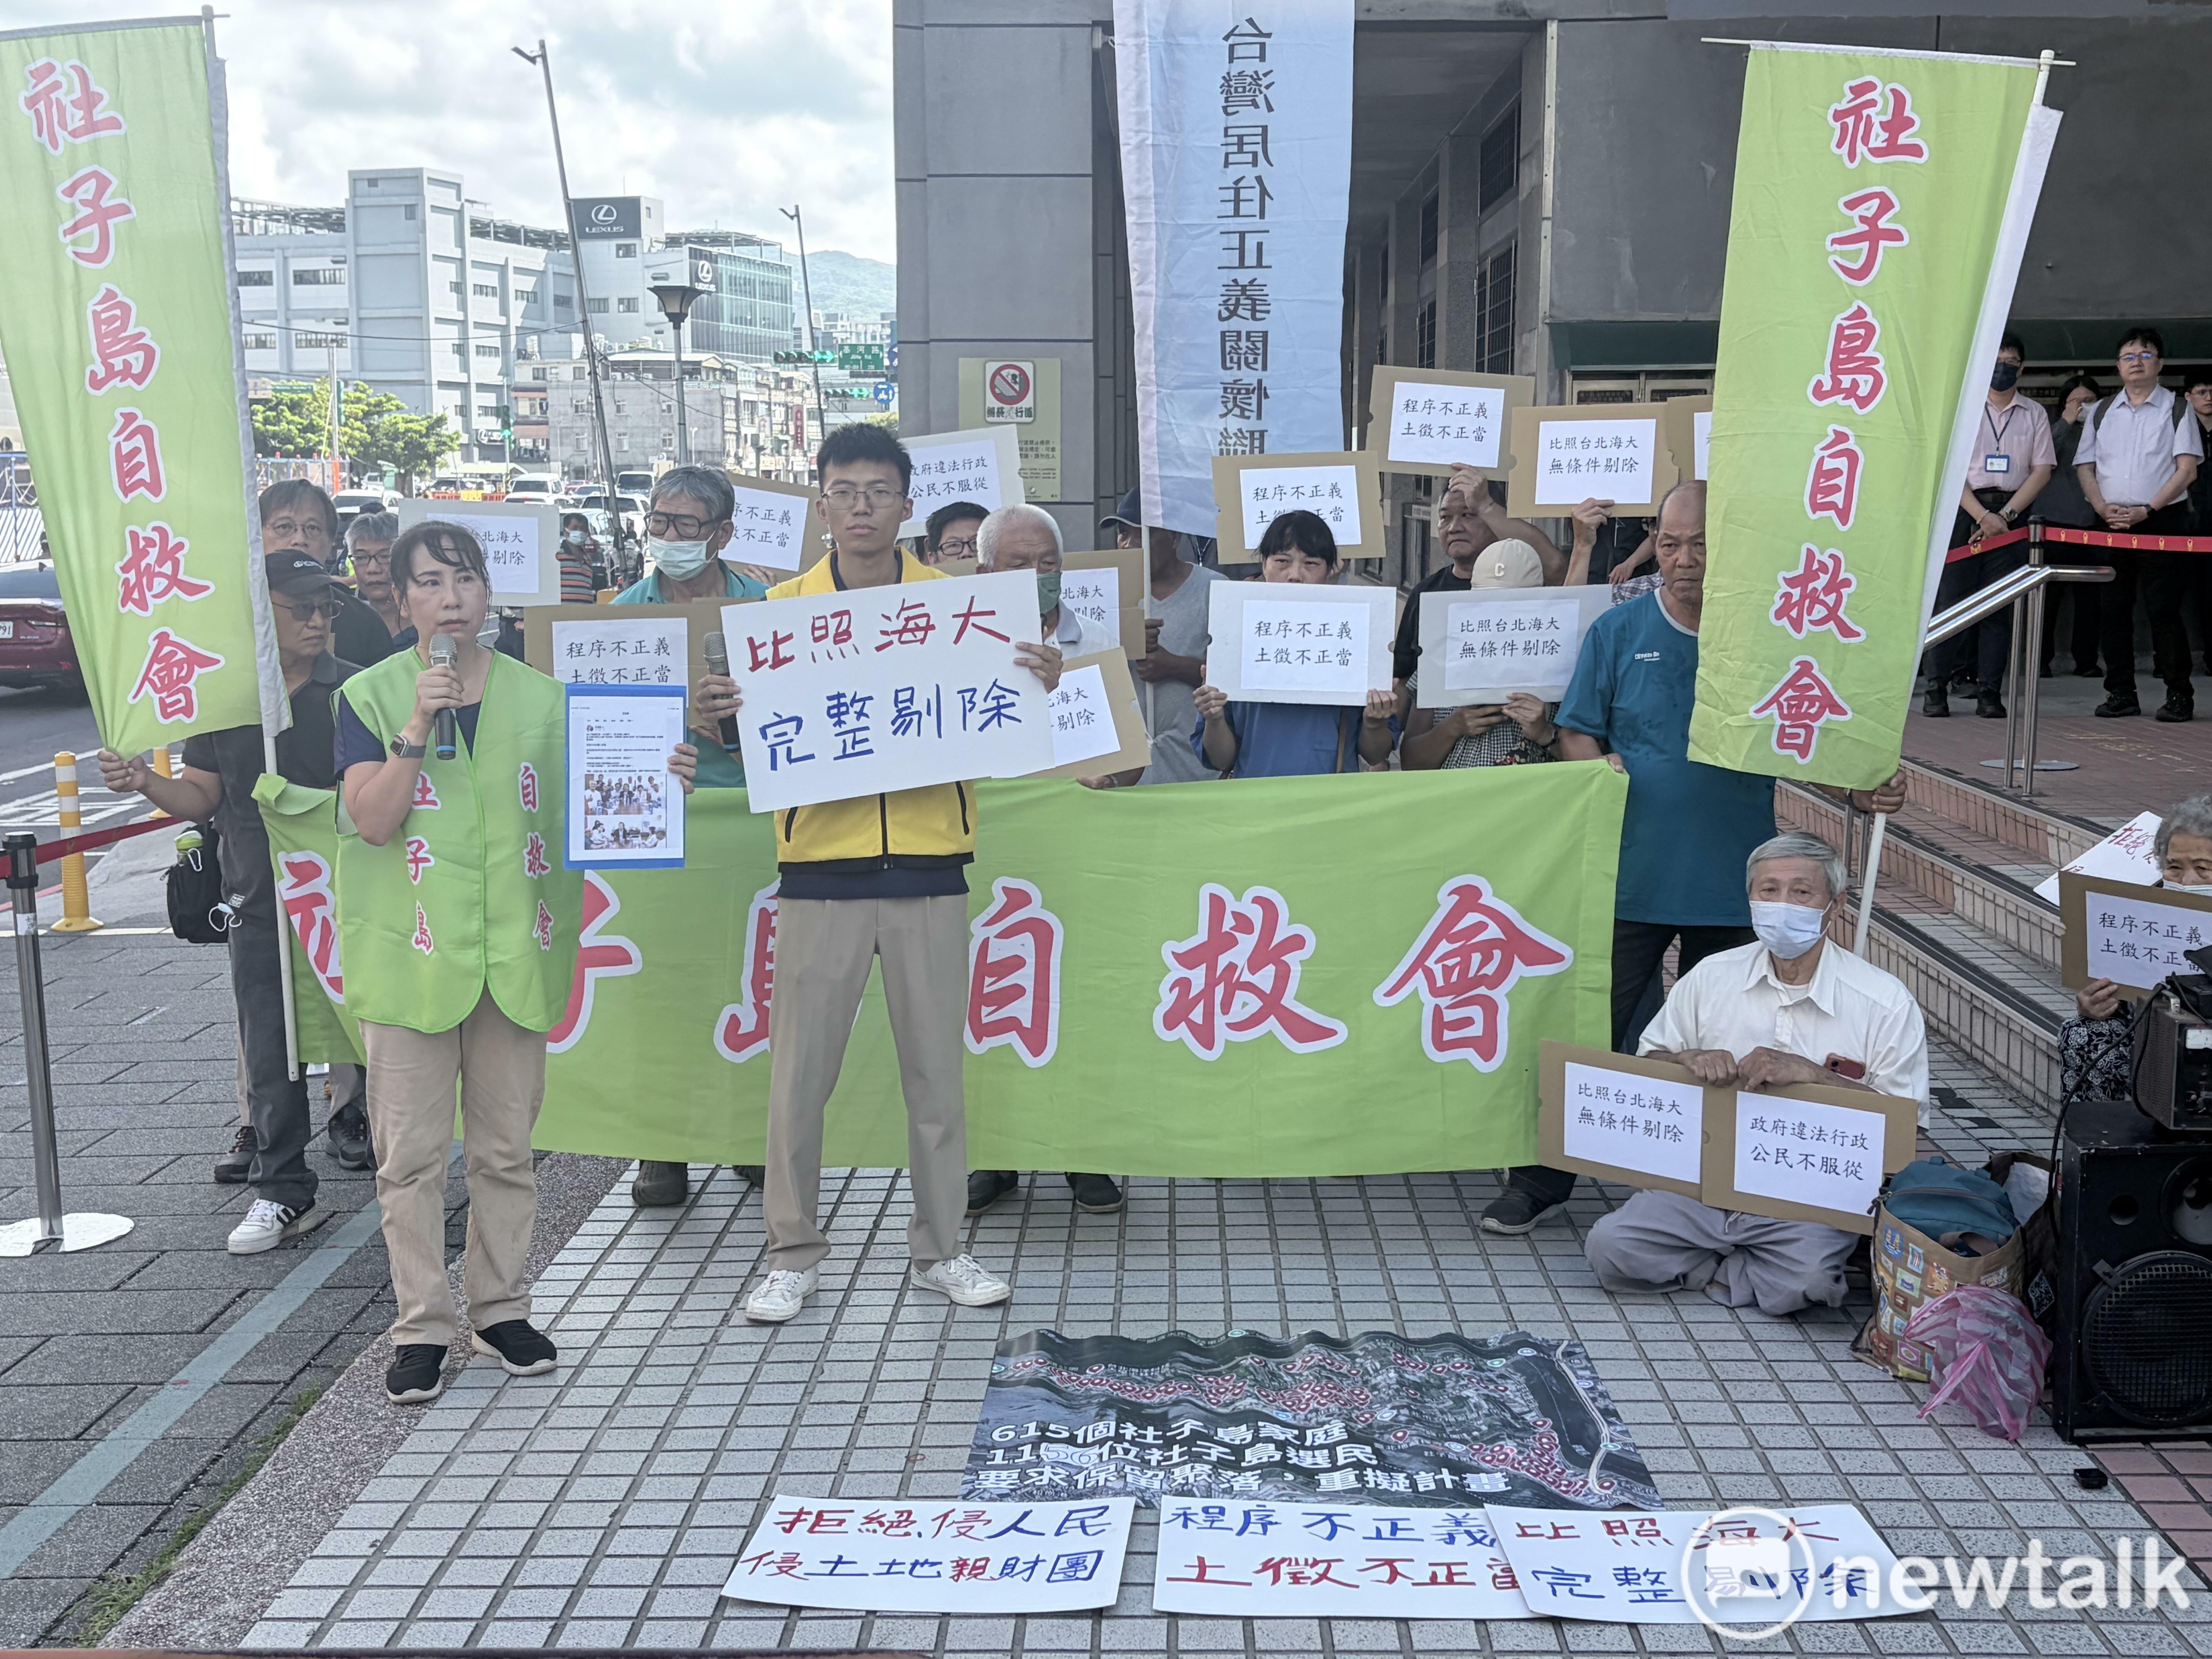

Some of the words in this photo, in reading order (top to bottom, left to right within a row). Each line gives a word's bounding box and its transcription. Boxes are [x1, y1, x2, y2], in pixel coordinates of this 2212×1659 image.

[22, 59, 223, 721] 社子島自救會
[1402, 398, 1487, 419] 程序不正義
[1752, 77, 1926, 761] 社子島自救會
[1401, 422, 1486, 442] 土徵不正當
[1550, 436, 1638, 449] 比照台北海大
[1549, 457, 1639, 474] 無條件剔除
[911, 477, 988, 498] 公民不服從
[1253, 482, 1343, 501] 程序不正義
[1256, 506, 1344, 524] 土正當
[484, 550, 525, 565] 剔除
[1495, 563, 1504, 577] C
[748, 595, 1011, 672] 比照海大
[1255, 620, 1352, 640] 程序不正義
[1461, 617, 1560, 632] 比照台北海大
[566, 637, 670, 658] 程序不正義
[1255, 647, 1352, 666] 土徵不正當
[1460, 639, 1561, 658] 無條件剔除
[570, 665, 671, 684] 土徵不正當
[759, 678, 1022, 771] 完整剔除
[1051, 709, 1095, 732] 剔除
[520, 763, 553, 950] 自救會
[2099, 912, 2203, 946] 程序不正義
[1578, 1083, 1683, 1116] 比照台北海大
[1577, 1106, 1685, 1144] 無條件剔除
[1750, 1116, 1869, 1151] 政府違法行政
[1750, 1143, 1864, 1181] 公民不服從
[991, 1419, 1348, 1446] 615個社子島家庭
[1163, 1504, 1496, 1547] 程序不正義
[740, 1549, 1104, 1583] 侵土地親財團
